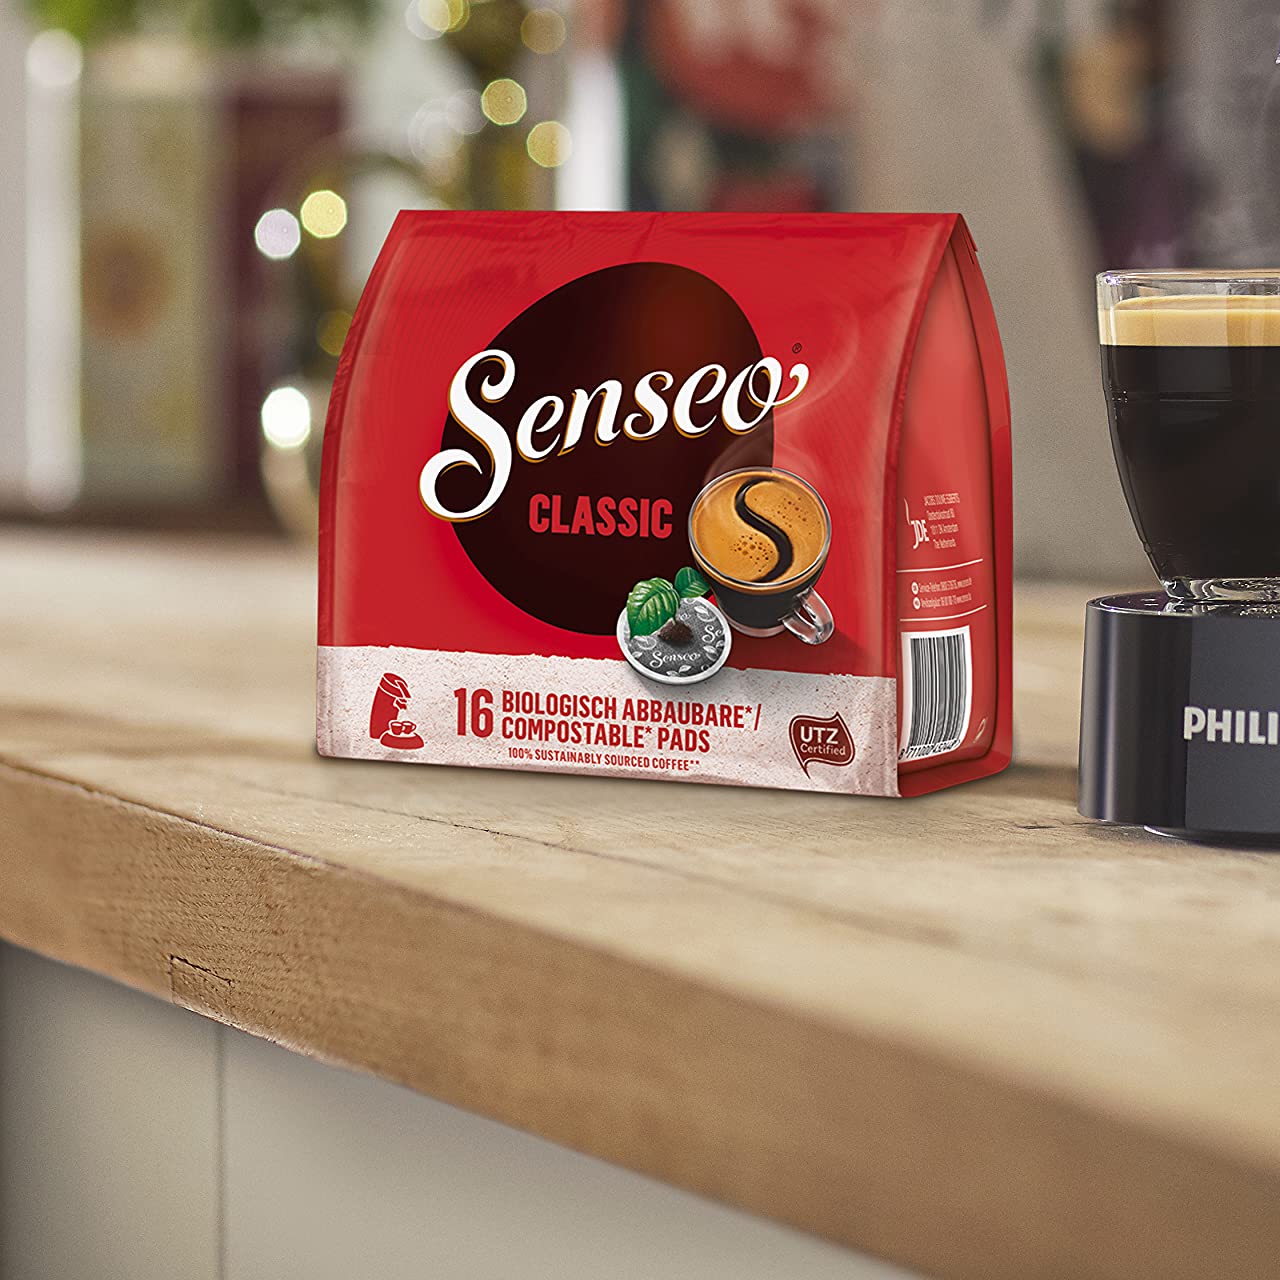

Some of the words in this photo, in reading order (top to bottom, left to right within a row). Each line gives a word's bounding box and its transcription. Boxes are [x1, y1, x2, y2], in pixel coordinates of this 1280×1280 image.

[419, 349, 809, 522] Senseo
[529, 493, 673, 539] CLASSIC
[649, 650, 701, 668] Senseo
[453, 687, 494, 739] 16
[502, 690, 617, 720] BIOLOGISCH
[657, 730, 711, 754] PADS
[800, 726, 839, 745] UTZ
[508, 746, 533, 760] 100%
[535, 749, 602, 766] SUSTAINABLY
[604, 754, 650, 768] SOURCED
[800, 743, 846, 756] Certified
